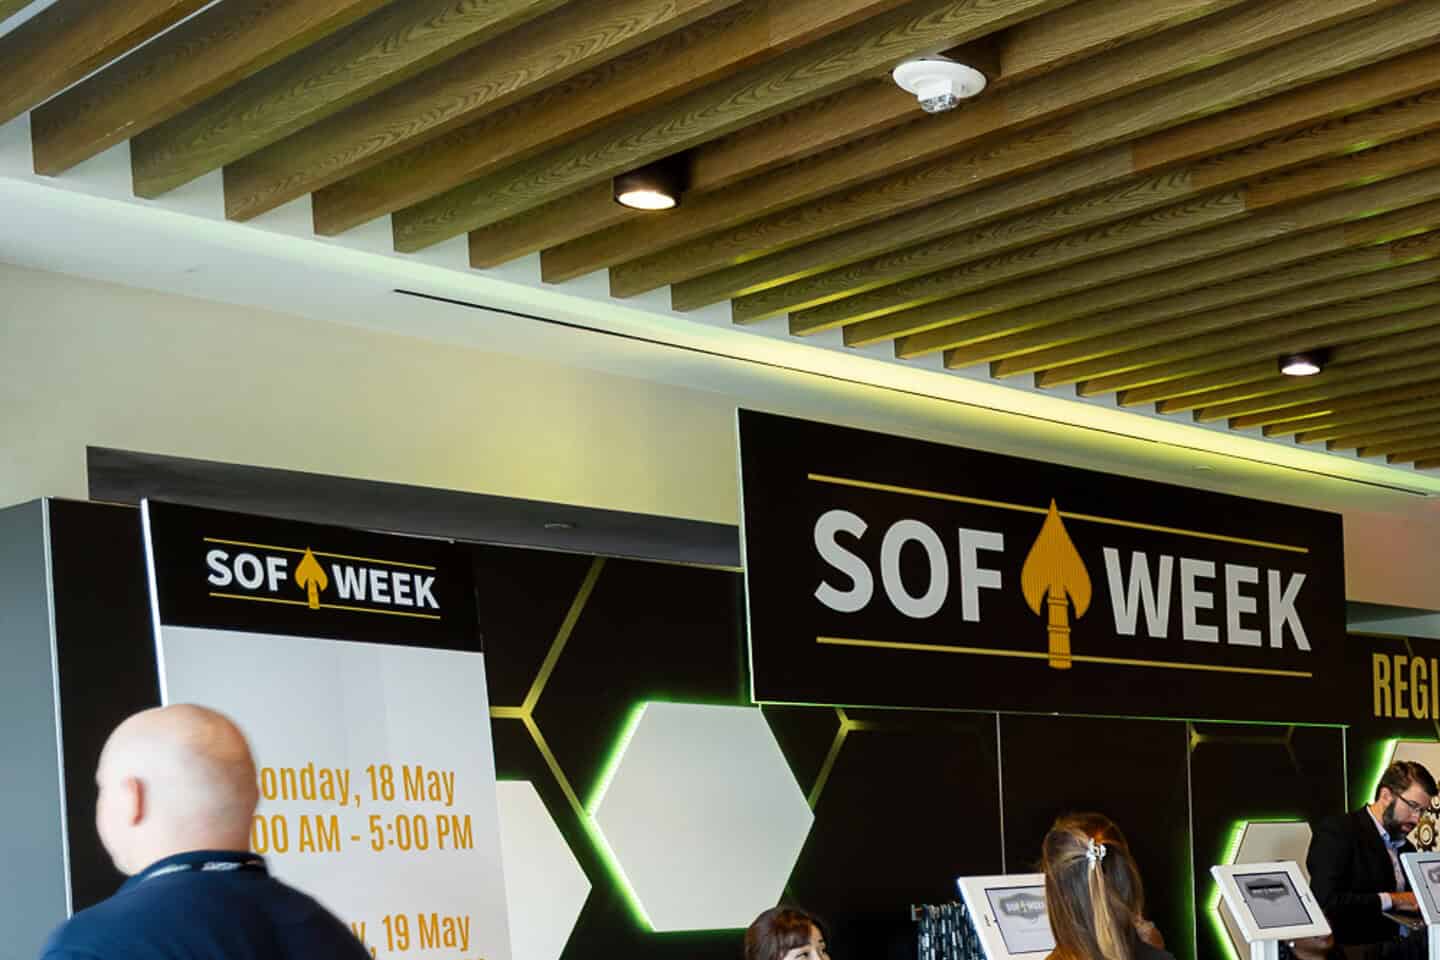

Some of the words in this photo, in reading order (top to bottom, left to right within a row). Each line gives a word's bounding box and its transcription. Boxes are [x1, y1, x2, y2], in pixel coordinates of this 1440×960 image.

[207, 548, 288, 592] SOF
[333, 564, 440, 610] WEEK
[813, 509, 1005, 623] SOF
[1103, 547, 1312, 652] WEEK
[260, 761, 361, 808] onday,
[367, 764, 393, 801] 18
[402, 764, 455, 806] May
[299, 814, 341, 853] AM
[369, 814, 428, 852] 5:00
[437, 814, 474, 850] PM
[382, 913, 410, 952] 19
[418, 913, 470, 952] May
